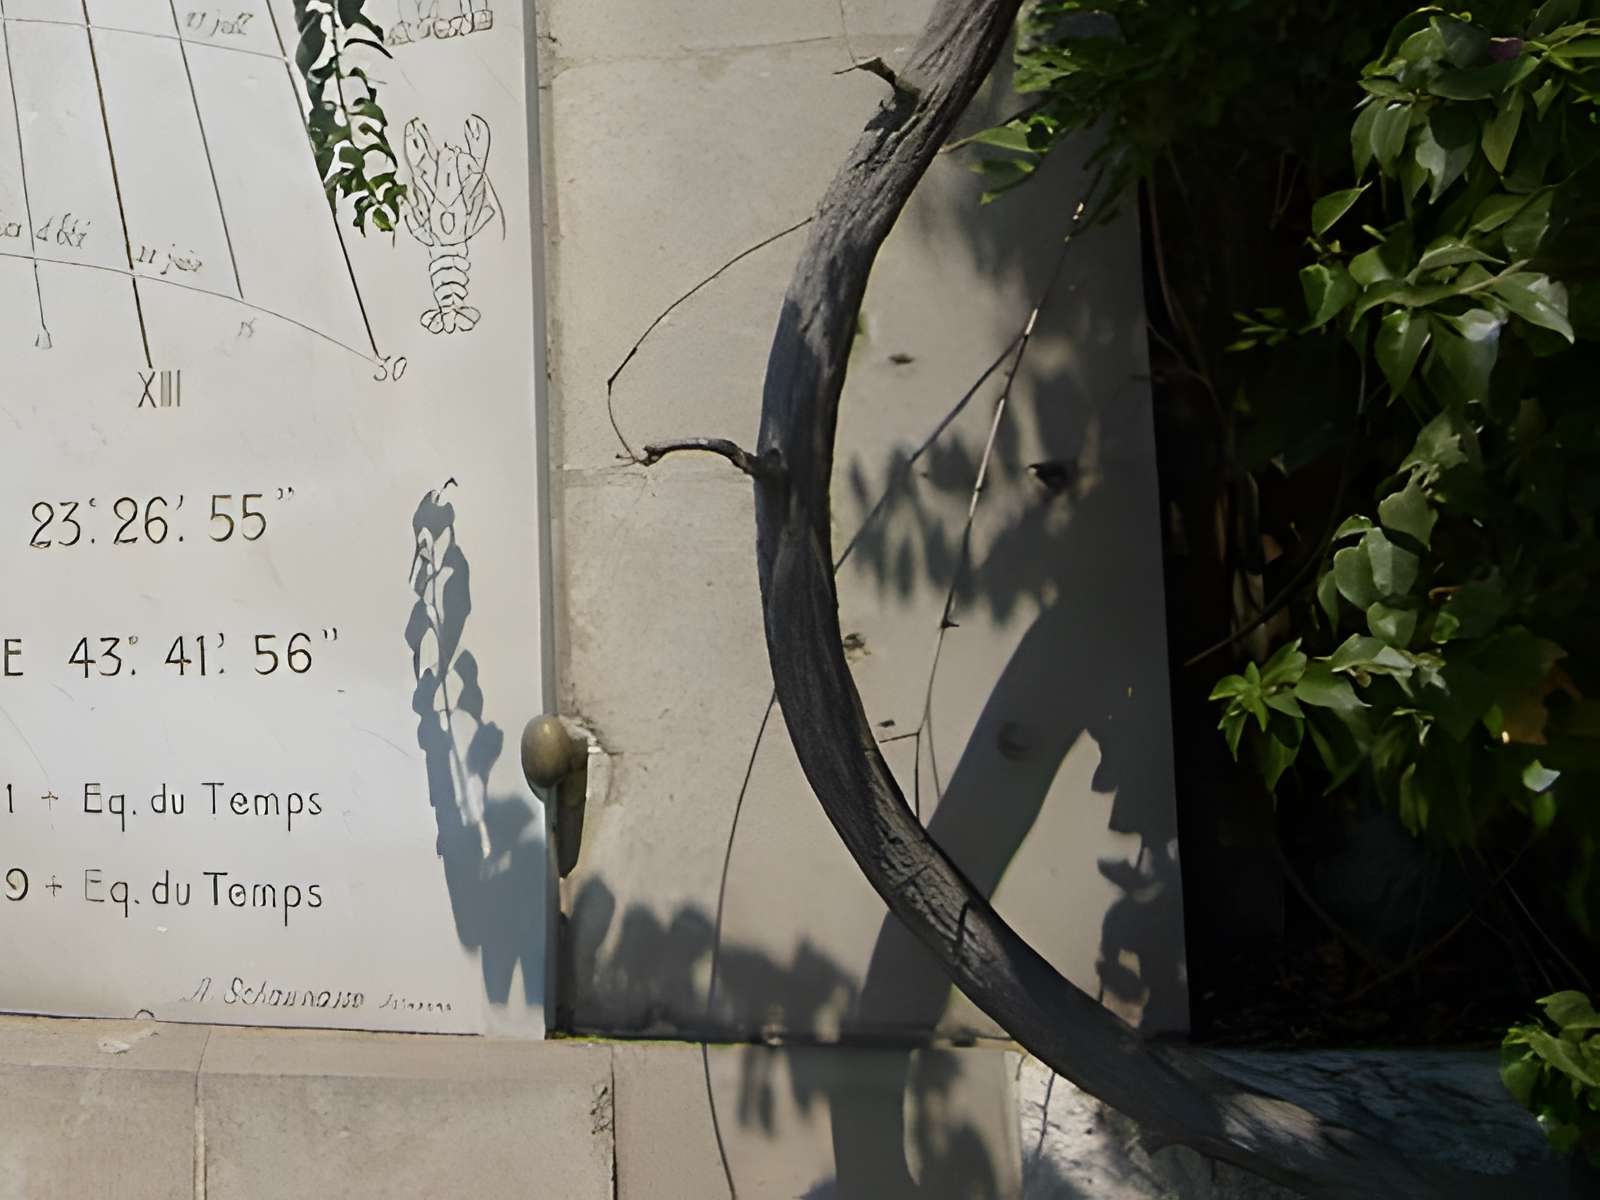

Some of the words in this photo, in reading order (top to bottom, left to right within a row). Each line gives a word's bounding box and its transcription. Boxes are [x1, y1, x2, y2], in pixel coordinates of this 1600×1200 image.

[151, 783, 184, 815] du
[200, 782, 322, 832] Temps
[152, 869, 190, 906] du
[203, 872, 322, 927] Temps
